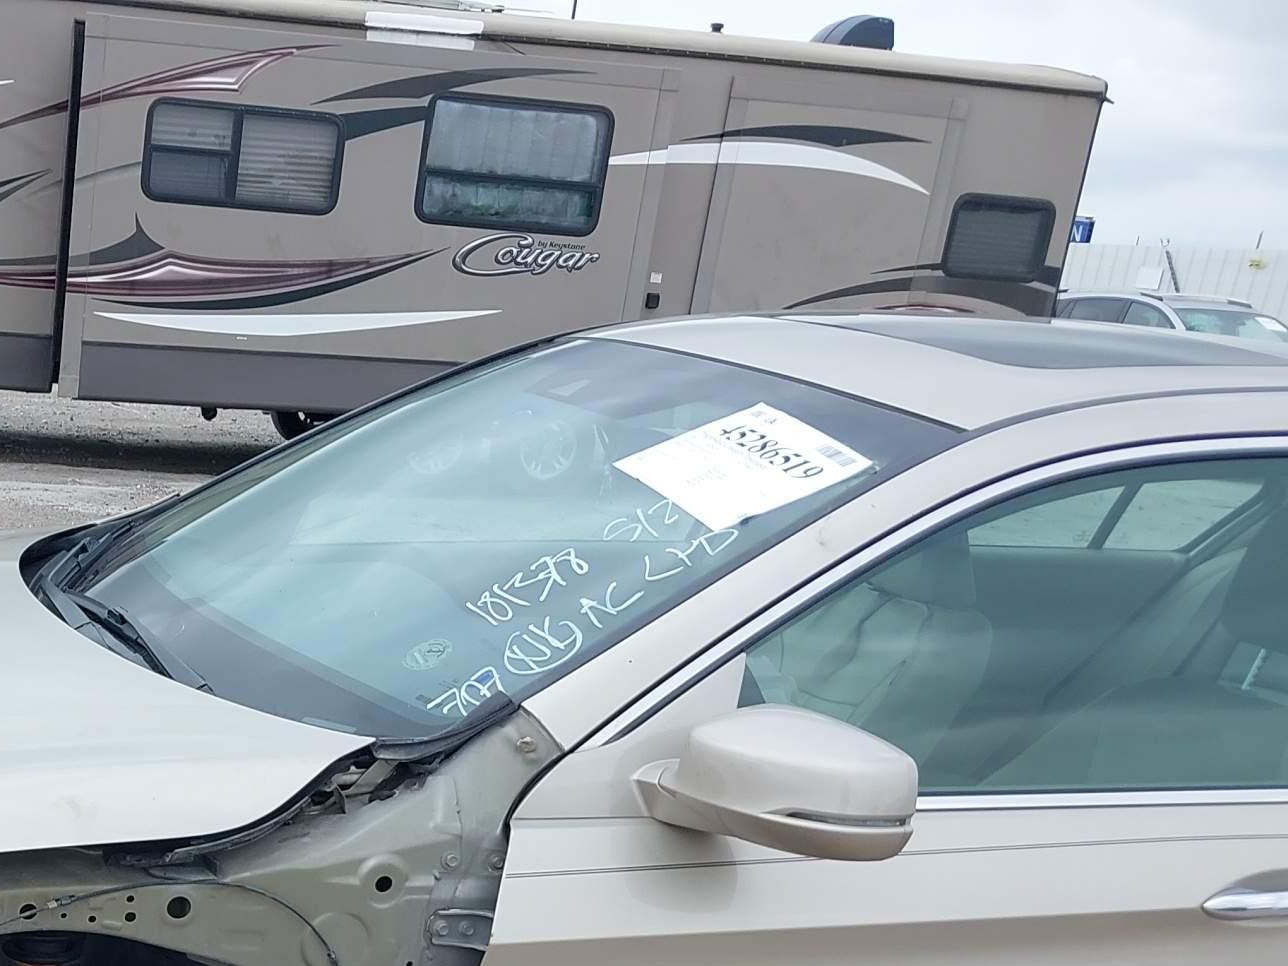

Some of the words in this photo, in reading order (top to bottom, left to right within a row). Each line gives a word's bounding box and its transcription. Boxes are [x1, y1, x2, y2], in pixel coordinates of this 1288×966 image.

[452, 232, 601, 276] Cougar
[537, 240, 549, 249] by
[549, 241, 586, 251] Keystone
[719, 424, 824, 479] 45286519
